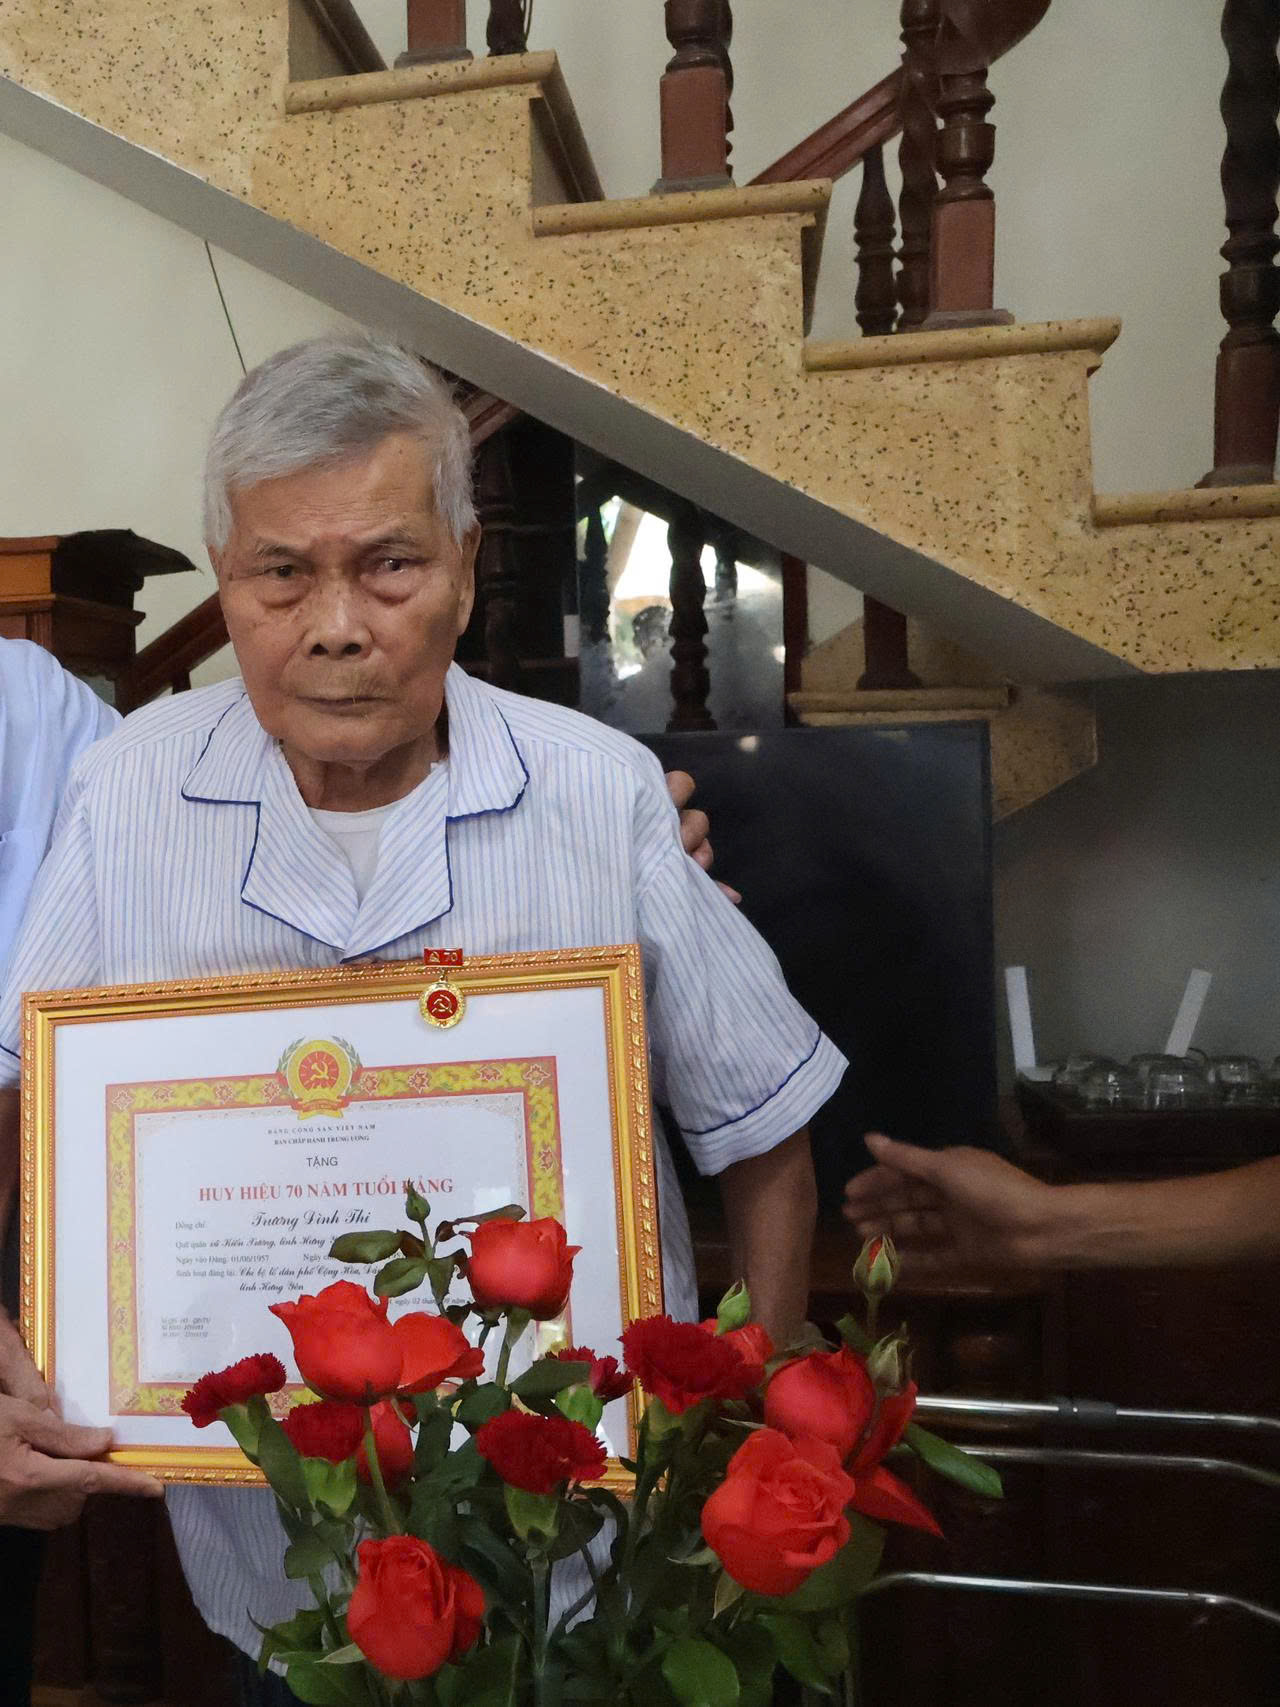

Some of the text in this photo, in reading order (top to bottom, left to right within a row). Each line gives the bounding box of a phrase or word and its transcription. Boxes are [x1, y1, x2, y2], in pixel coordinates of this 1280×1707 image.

[306, 1155, 338, 1168] TẶNG
[199, 1186, 234, 1201] HUY
[240, 1182, 281, 1202] HIỆU
[286, 1184, 303, 1198] 70
[307, 1180, 347, 1198] NĂM
[352, 1174, 396, 1196] TUỔI
[344, 1208, 371, 1224] Thi
